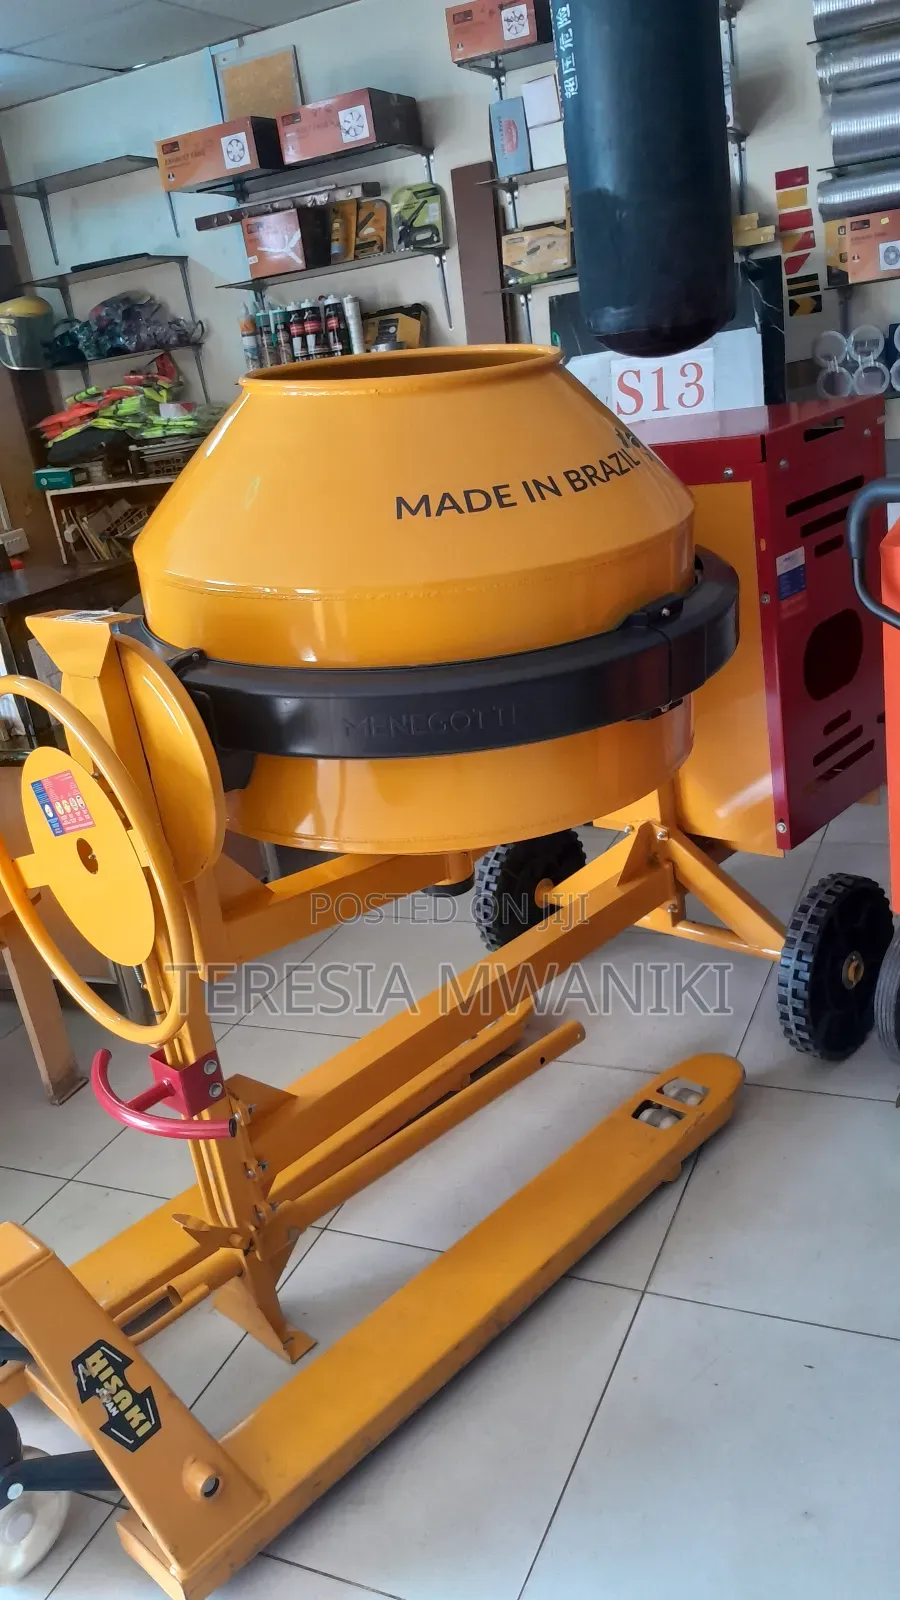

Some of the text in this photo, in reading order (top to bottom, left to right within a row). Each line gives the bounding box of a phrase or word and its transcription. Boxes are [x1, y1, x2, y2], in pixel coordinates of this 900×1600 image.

[616, 362, 705, 416] S13
[395, 448, 641, 520] MADE IN BRAZIL
[343, 702, 516, 738] MENEGOTTI
